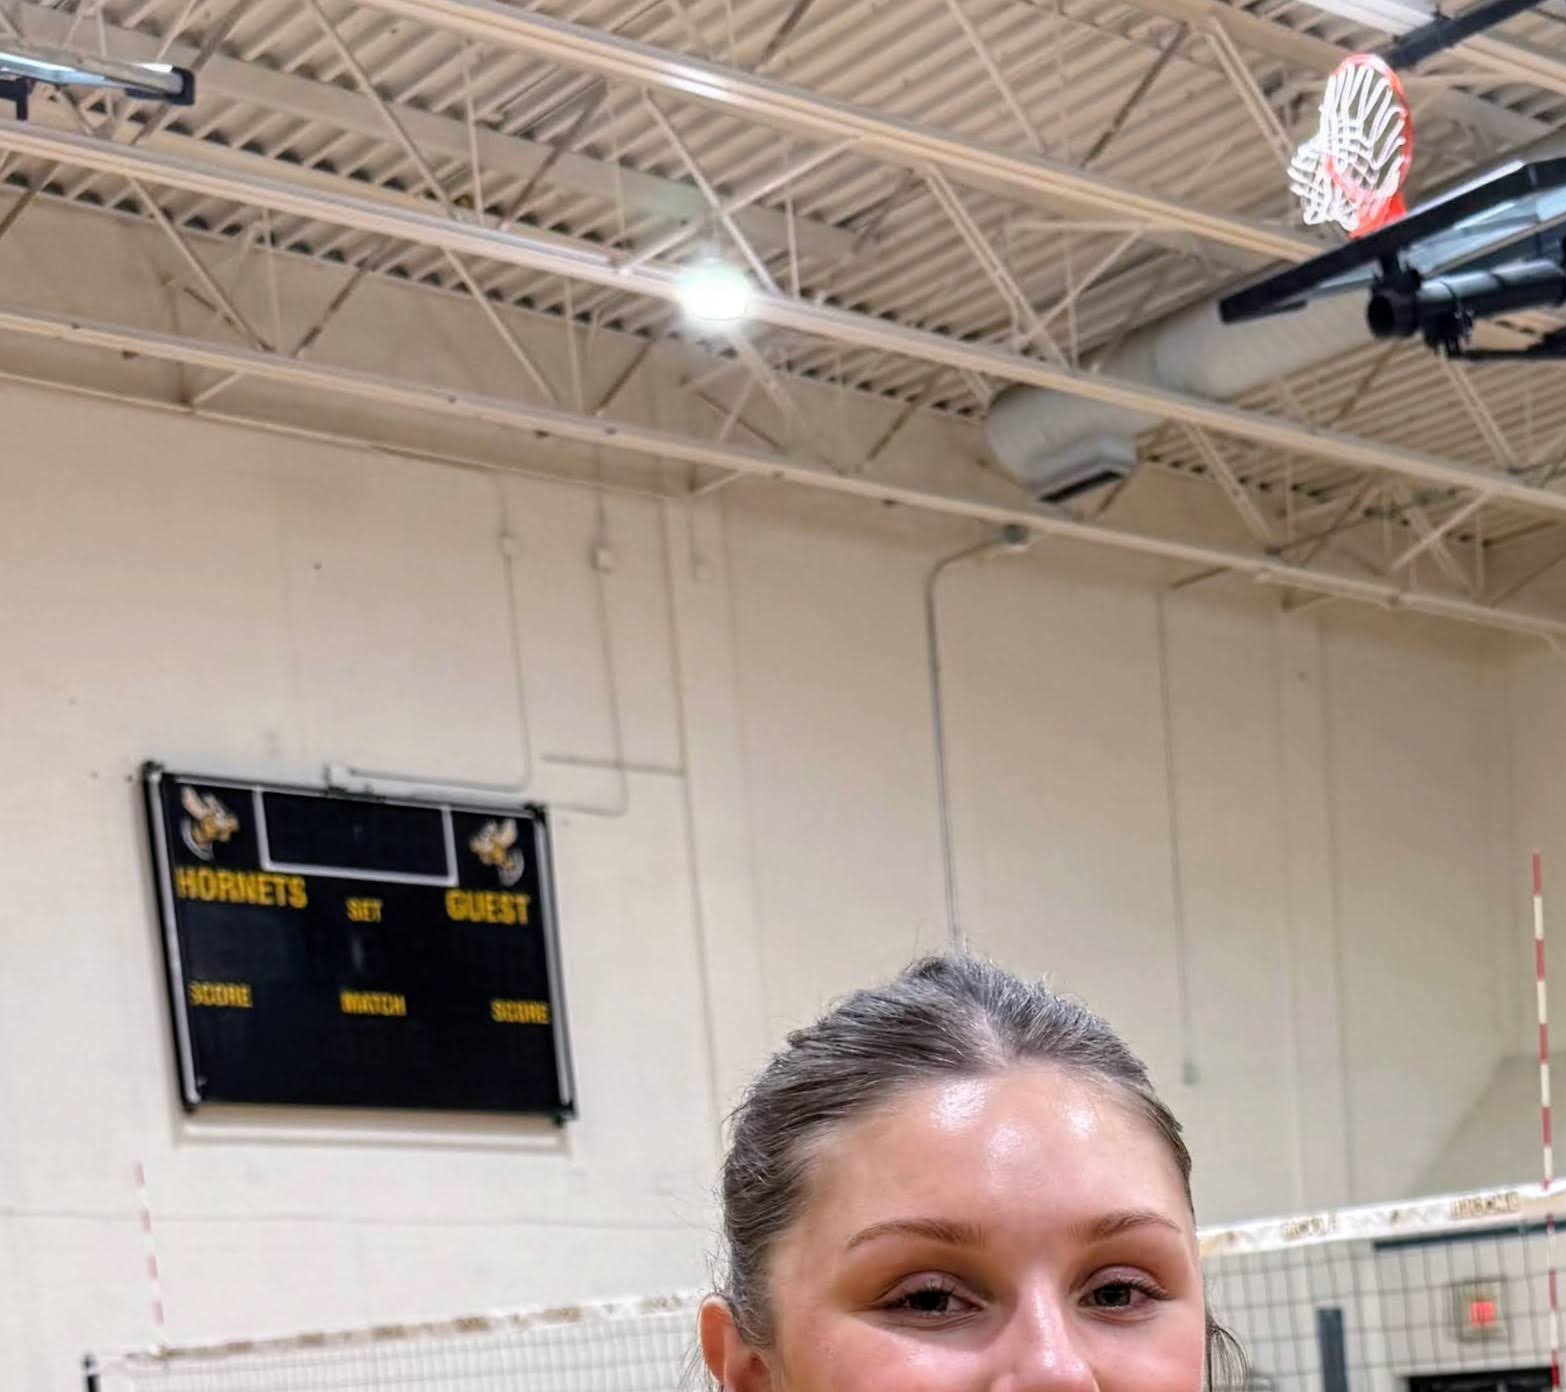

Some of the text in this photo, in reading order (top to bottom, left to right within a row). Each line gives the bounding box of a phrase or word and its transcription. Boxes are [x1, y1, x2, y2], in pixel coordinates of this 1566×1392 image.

[176, 867, 530, 925] HORNETS GUEST
[347, 898, 382, 923] SET
[189, 981, 253, 1008] SCORE
[490, 1000, 550, 1024] SCORE
